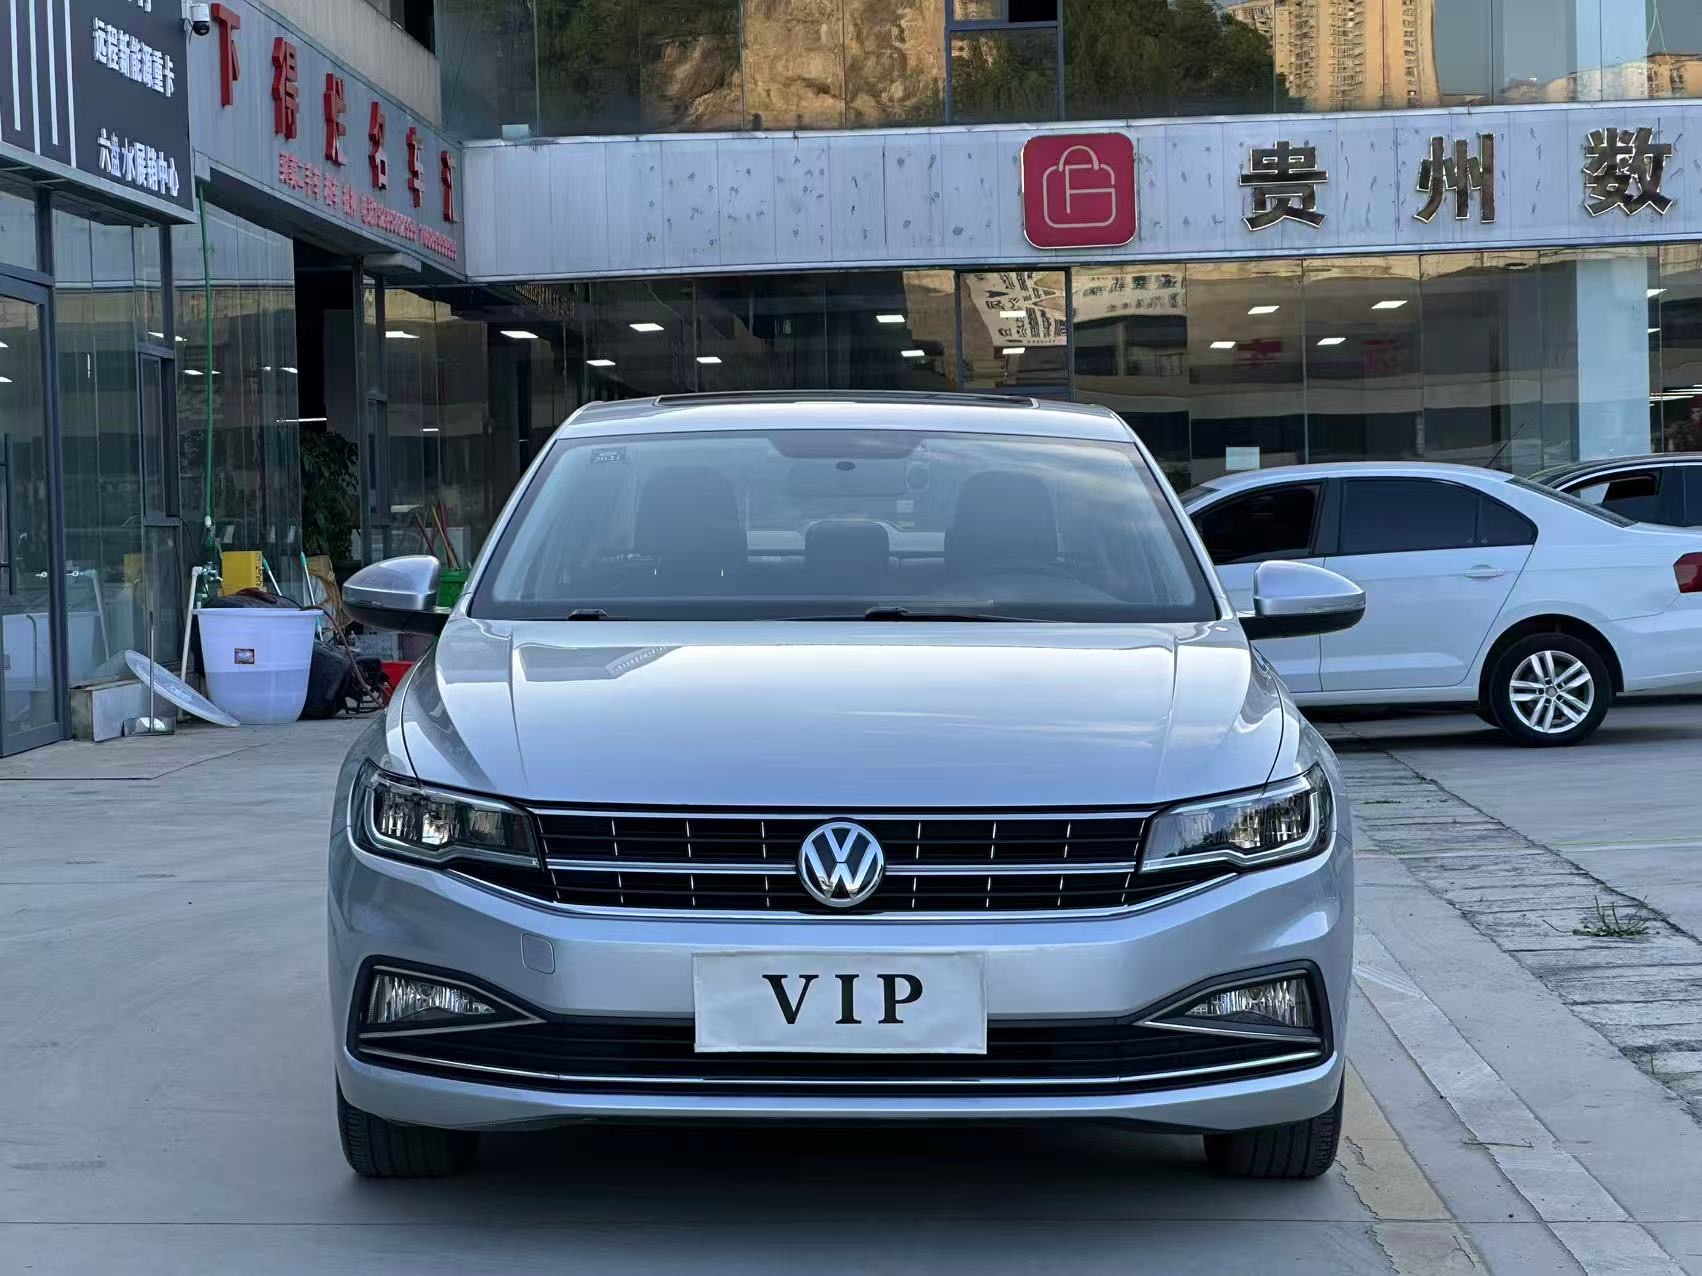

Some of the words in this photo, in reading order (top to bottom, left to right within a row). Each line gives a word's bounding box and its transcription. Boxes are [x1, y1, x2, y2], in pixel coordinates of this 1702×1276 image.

[93, 17, 174, 97] 远程新能源重卡
[98, 128, 179, 197] 六盘水展销中心
[1239, 126, 1673, 230] 贵州数
[762, 973, 923, 1024] VIP
